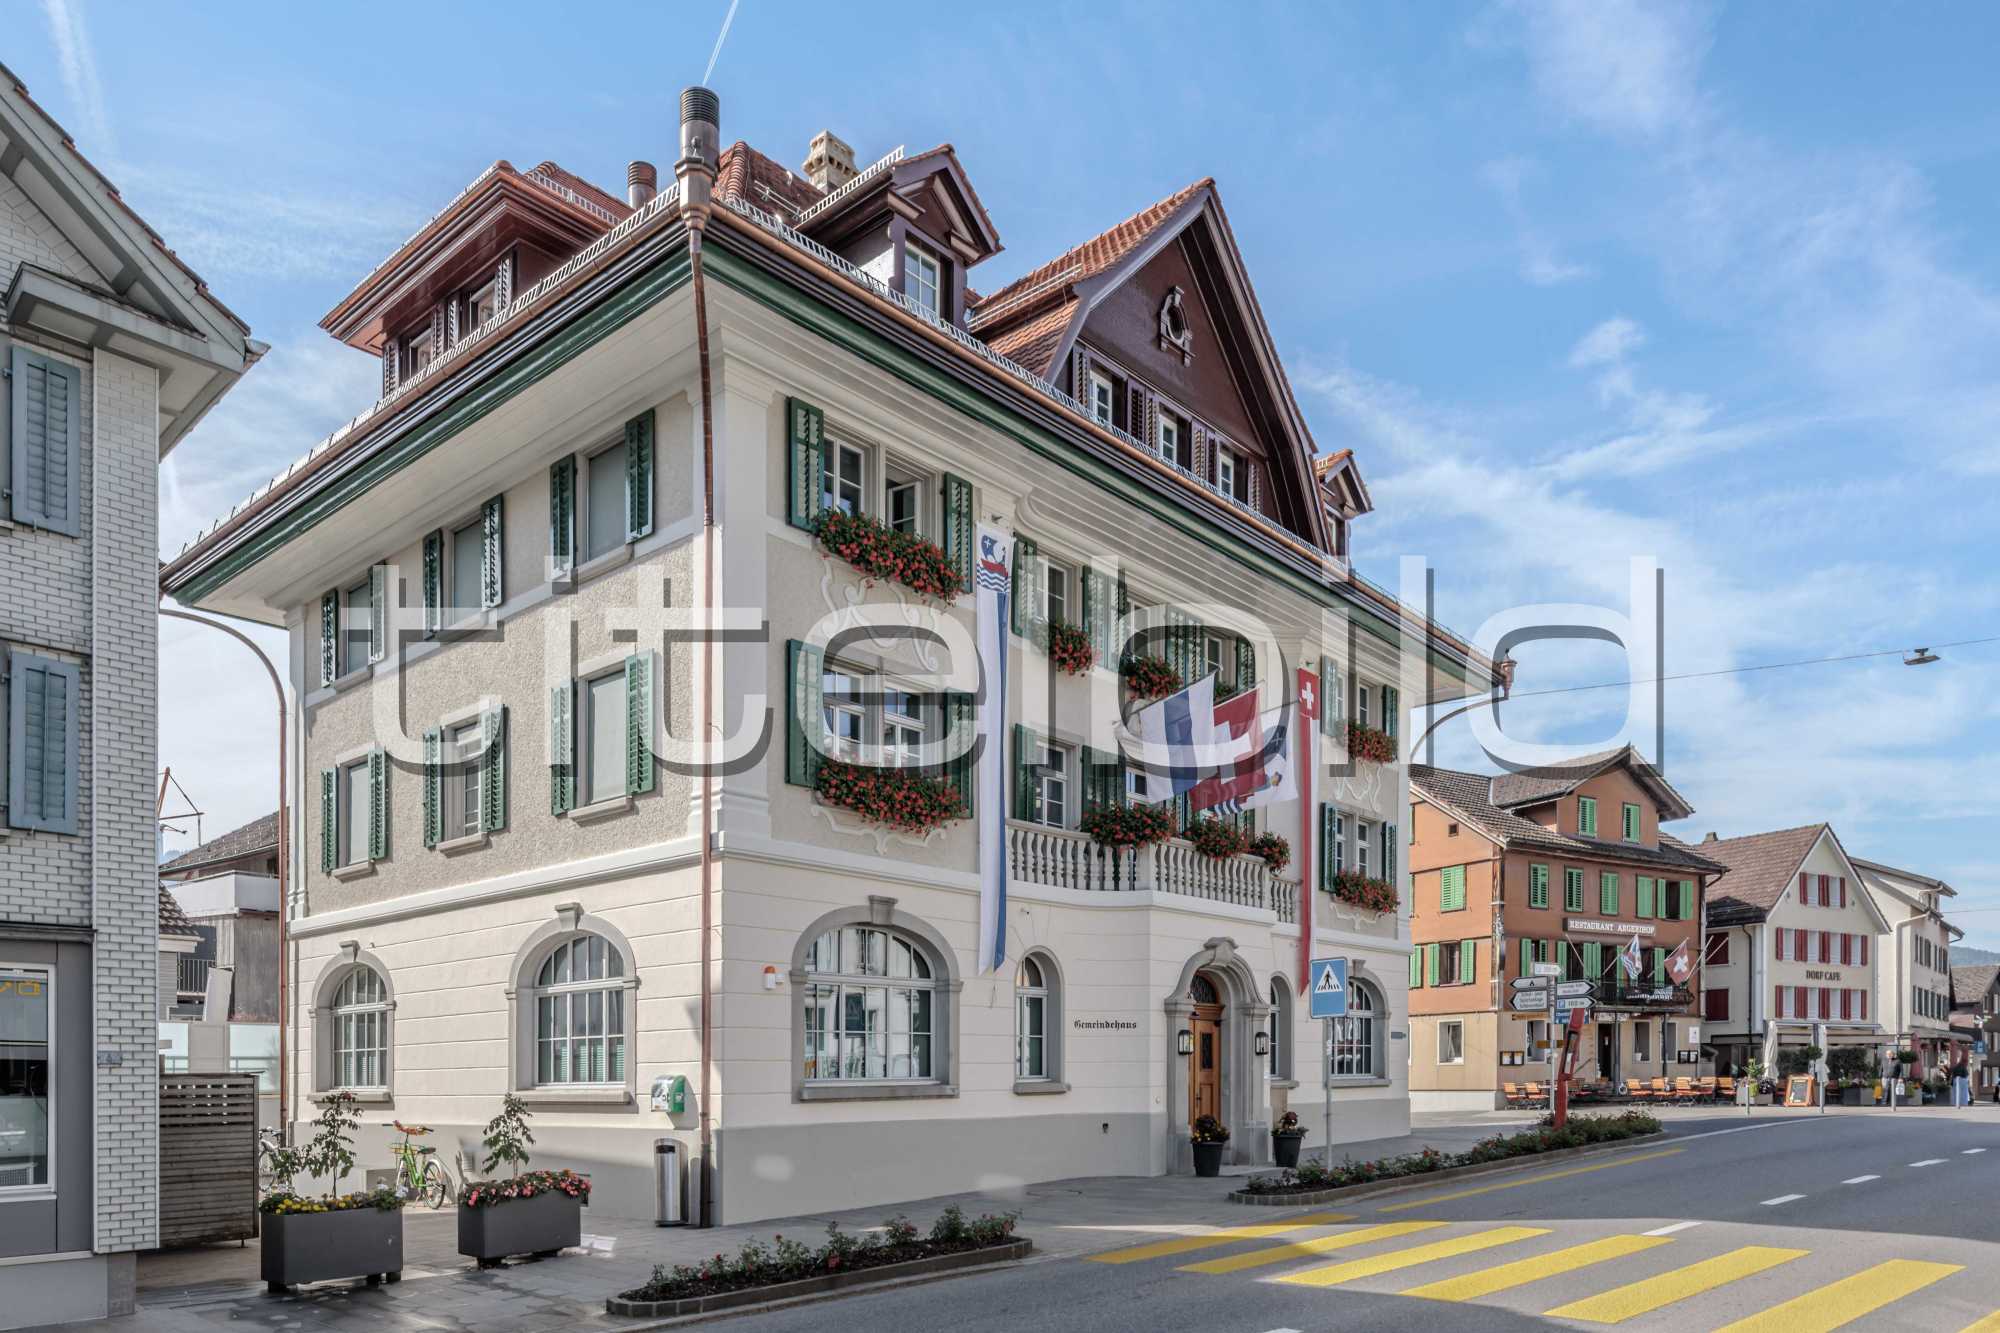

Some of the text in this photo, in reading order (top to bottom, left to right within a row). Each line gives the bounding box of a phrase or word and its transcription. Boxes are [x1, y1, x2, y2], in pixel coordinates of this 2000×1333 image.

[1569, 920, 1613, 931] RESTAURANT
[1806, 970, 1824, 980] DORF
[1074, 1019, 1137, 1031] Gemeindehaus
